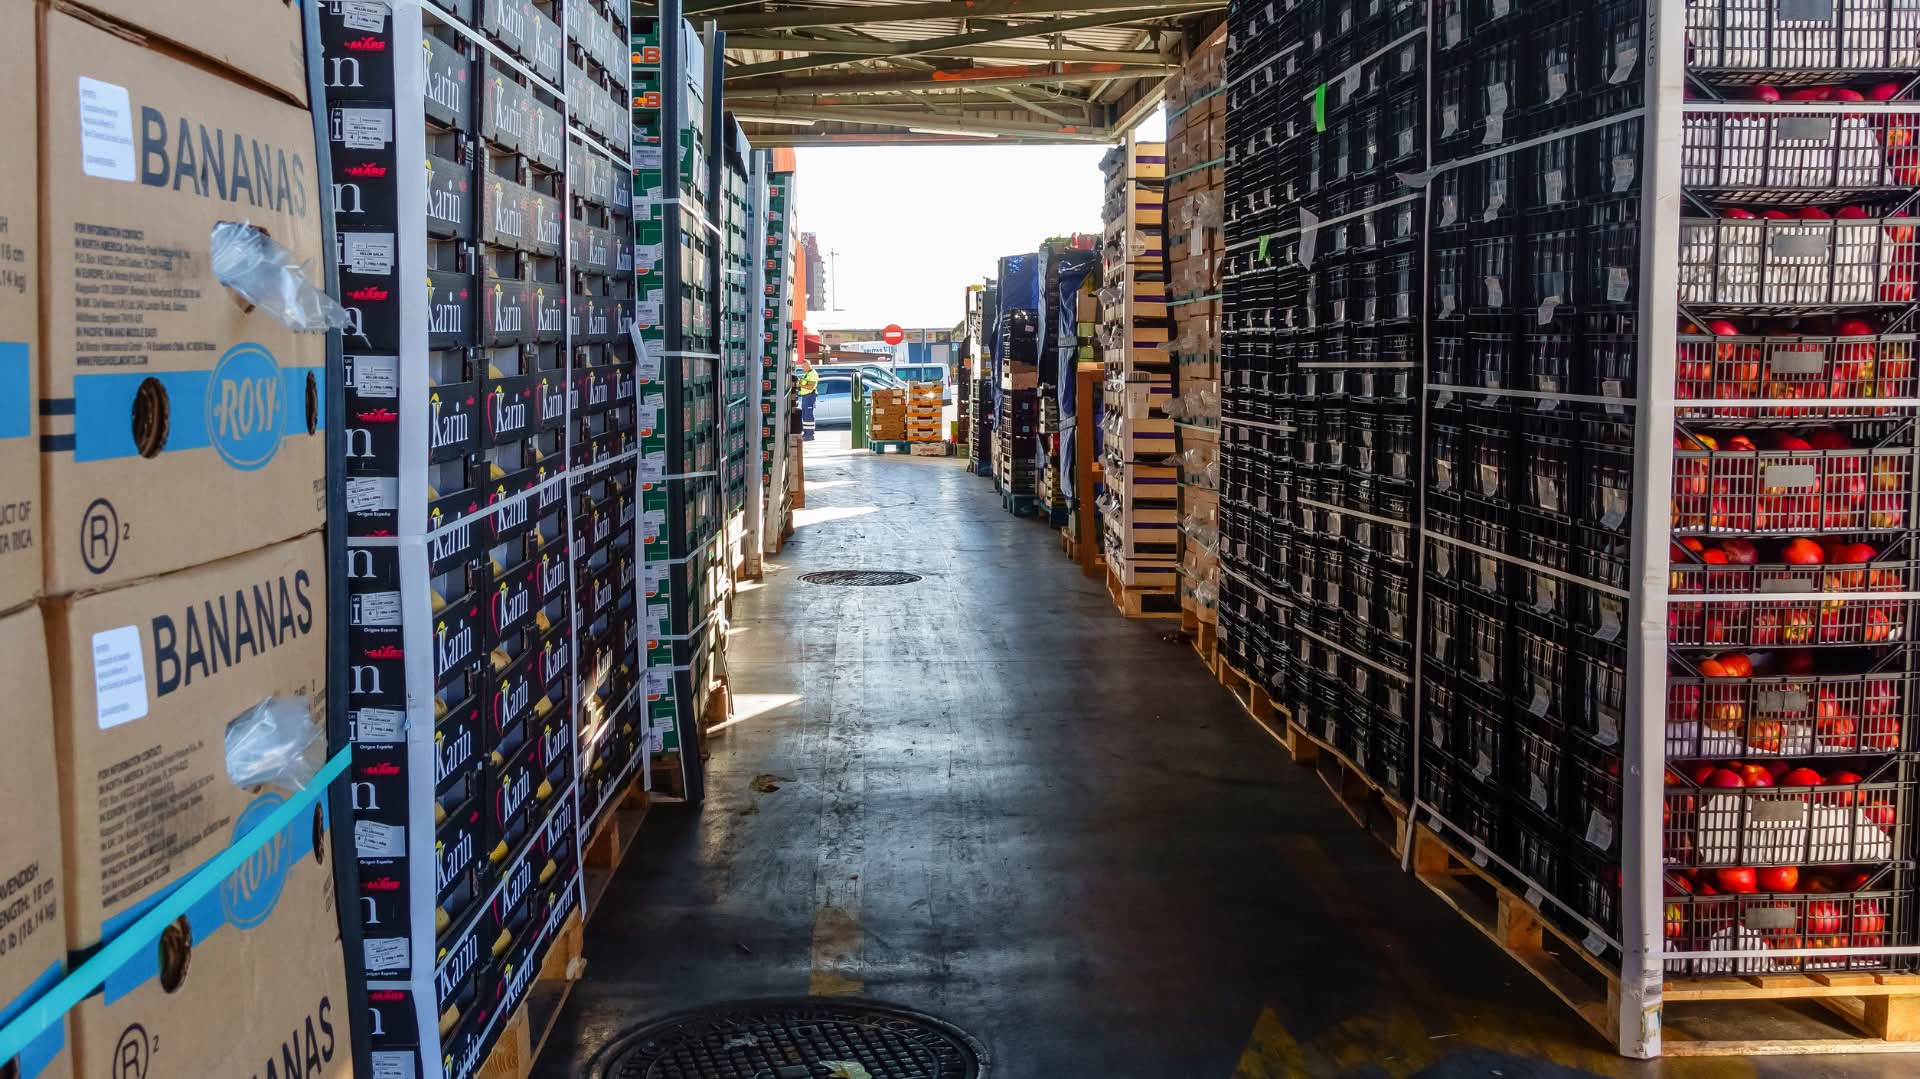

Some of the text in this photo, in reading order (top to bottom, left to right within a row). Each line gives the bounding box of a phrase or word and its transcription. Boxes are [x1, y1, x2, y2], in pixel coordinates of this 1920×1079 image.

[423, 49, 460, 113] Karin
[496, 84, 522, 138] Karin
[141, 105, 305, 218] BANANAS
[538, 114, 560, 161] Karin
[425, 168, 461, 224] Karin
[592, 168, 608, 198] Karin
[496, 190, 522, 238] Karin
[537, 203, 560, 246] Karin
[588, 234, 607, 266] Karin
[616, 240, 632, 270] Karin
[427, 286, 462, 333] Karin
[495, 291, 521, 332] Karin
[538, 294, 561, 331] Karin
[588, 304, 607, 335] Karin
[219, 376, 277, 441] ROSY
[542, 384, 563, 420] Karin
[590, 374, 608, 404] Karin
[616, 373, 633, 400] Karin
[432, 401, 468, 449] Karin
[495, 392, 526, 433] Karin
[498, 491, 528, 533] Karin
[594, 512, 610, 544] Karin
[432, 513, 470, 562] Karin
[543, 554, 565, 596] Karin
[594, 583, 612, 612] Karin
[500, 581, 528, 630] Karin
[152, 569, 312, 698] BANANAS
[438, 618, 472, 677] Karin
[545, 638, 568, 683] Karin
[596, 648, 613, 681] Karin
[502, 676, 529, 729] Karin
[435, 724, 472, 786] Karin
[545, 720, 569, 768] Karin
[504, 767, 530, 824] Karin
[548, 796, 571, 851] Karin
[436, 830, 472, 897] Karin
[503, 859, 532, 920] Karin
[440, 934, 478, 1005] Karin
[267, 995, 334, 1079] ANAS
